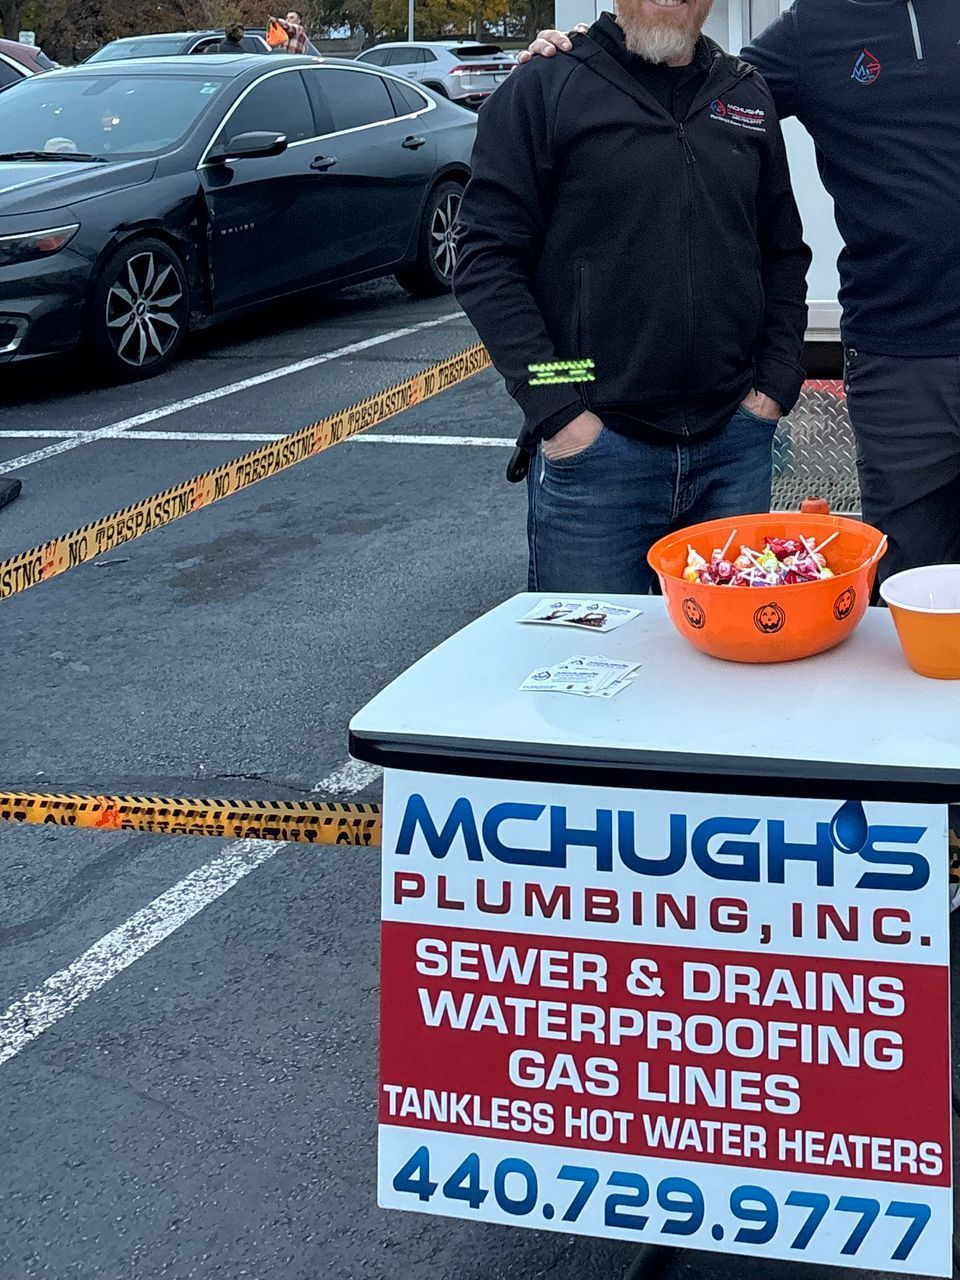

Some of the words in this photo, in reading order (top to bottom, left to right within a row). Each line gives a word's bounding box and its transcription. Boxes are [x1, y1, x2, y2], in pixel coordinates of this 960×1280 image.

[423, 373, 436, 398] NO
[438, 347, 490, 390] TRESPASSIN
[212, 472, 231, 502] NO
[235, 431, 316, 491] TRESPASSING
[328, 419, 344, 446] NO
[67, 535, 89, 571] NO
[95, 487, 195, 557] TRESPASSING
[393, 871, 772, 944] PLUMBING,
[792, 902, 932, 947] INC.
[416, 937, 608, 993] SEWER
[625, 958, 665, 998] &
[682, 961, 905, 1017] DRAINS
[417, 987, 904, 1070] WATERPROOFING
[508, 1048, 620, 1098] GAS
[637, 1061, 801, 1115] LINES
[383, 1084, 555, 1136] TANKLESS
[564, 1105, 635, 1145] HOT
[642, 1113, 768, 1160] WATER
[777, 1127, 943, 1177] HEATERS
[392, 1145, 932, 1261] 440.729.9777
